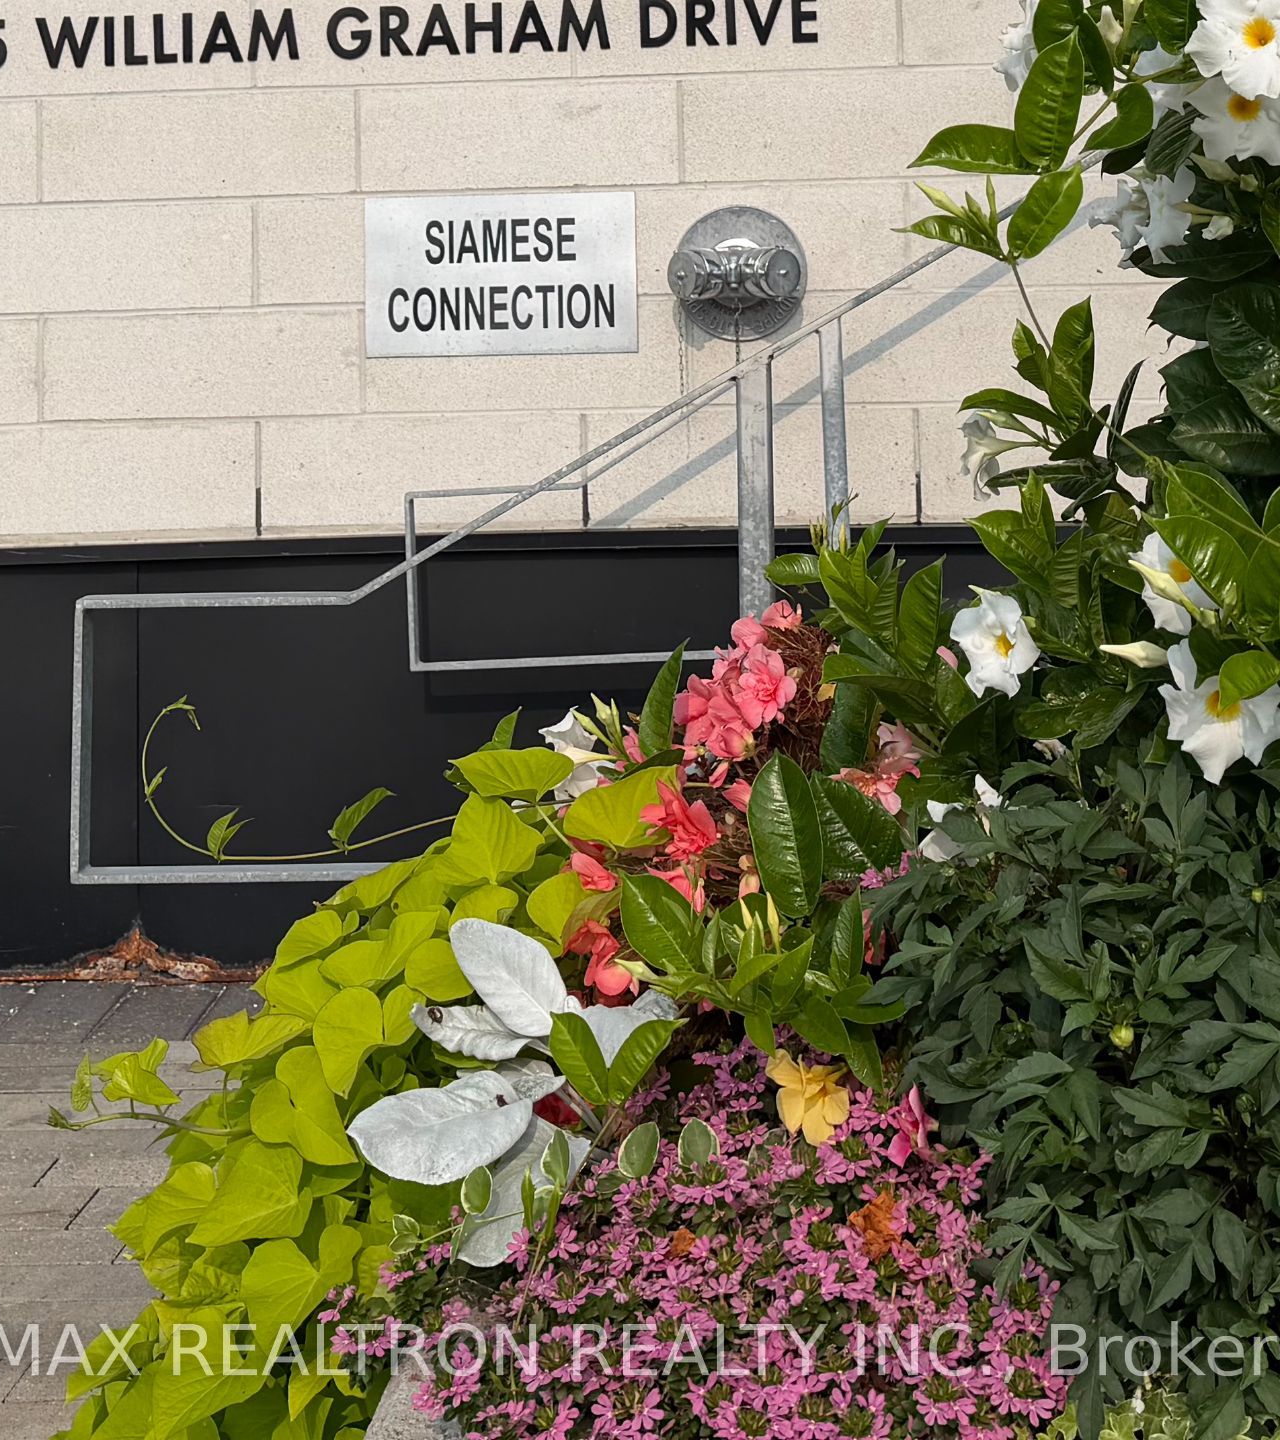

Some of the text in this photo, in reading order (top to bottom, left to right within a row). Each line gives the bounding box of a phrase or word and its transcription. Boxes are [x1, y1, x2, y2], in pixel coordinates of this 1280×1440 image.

[35, 8, 301, 69] WILLIAM
[425, 217, 577, 265] SIAMESE
[388, 283, 616, 333] CONNECTION
